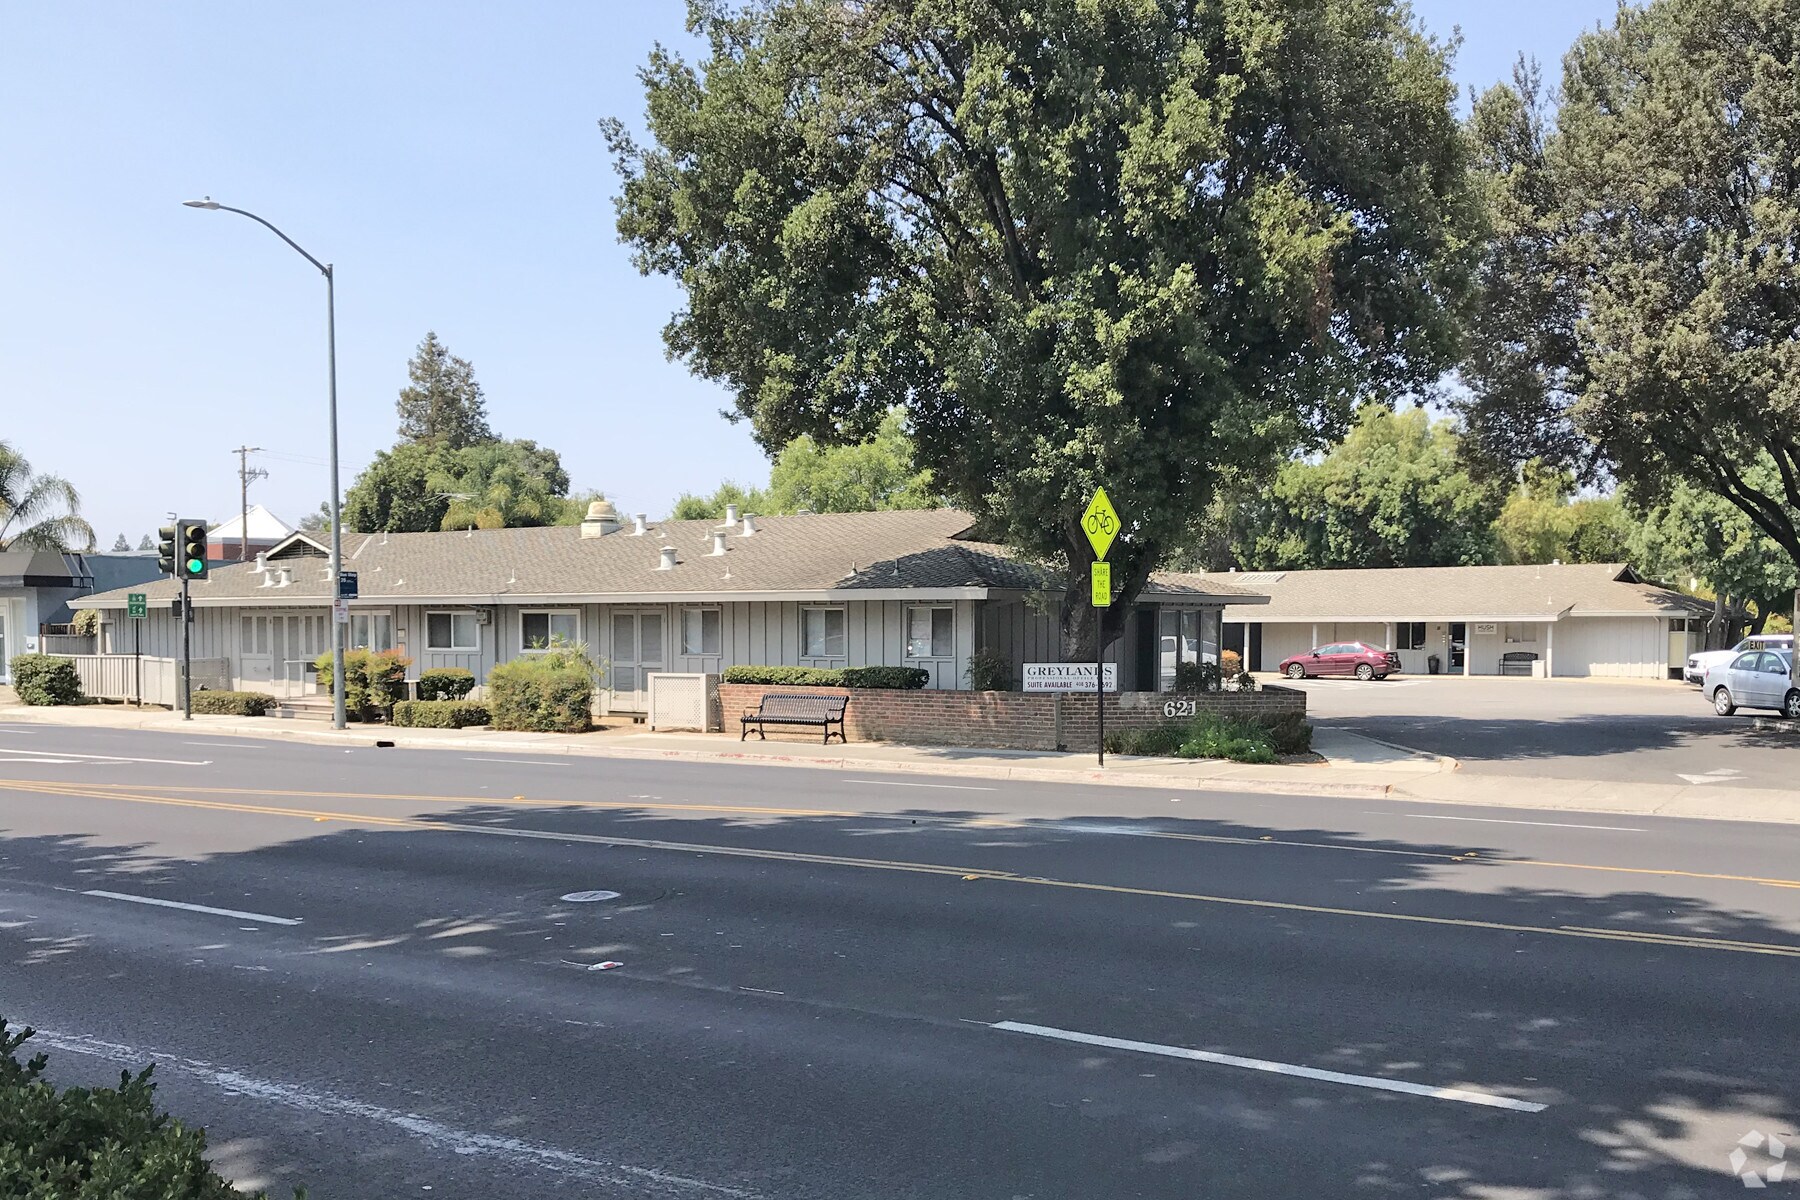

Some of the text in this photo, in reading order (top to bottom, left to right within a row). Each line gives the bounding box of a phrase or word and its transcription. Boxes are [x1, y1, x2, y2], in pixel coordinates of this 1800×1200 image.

[1094, 568, 1108, 577] SHARE
[1097, 579, 1106, 588] THE
[1095, 591, 1108, 600] ROAD
[1750, 641, 1765, 650] EXIT
[1163, 700, 1196, 718] 621
